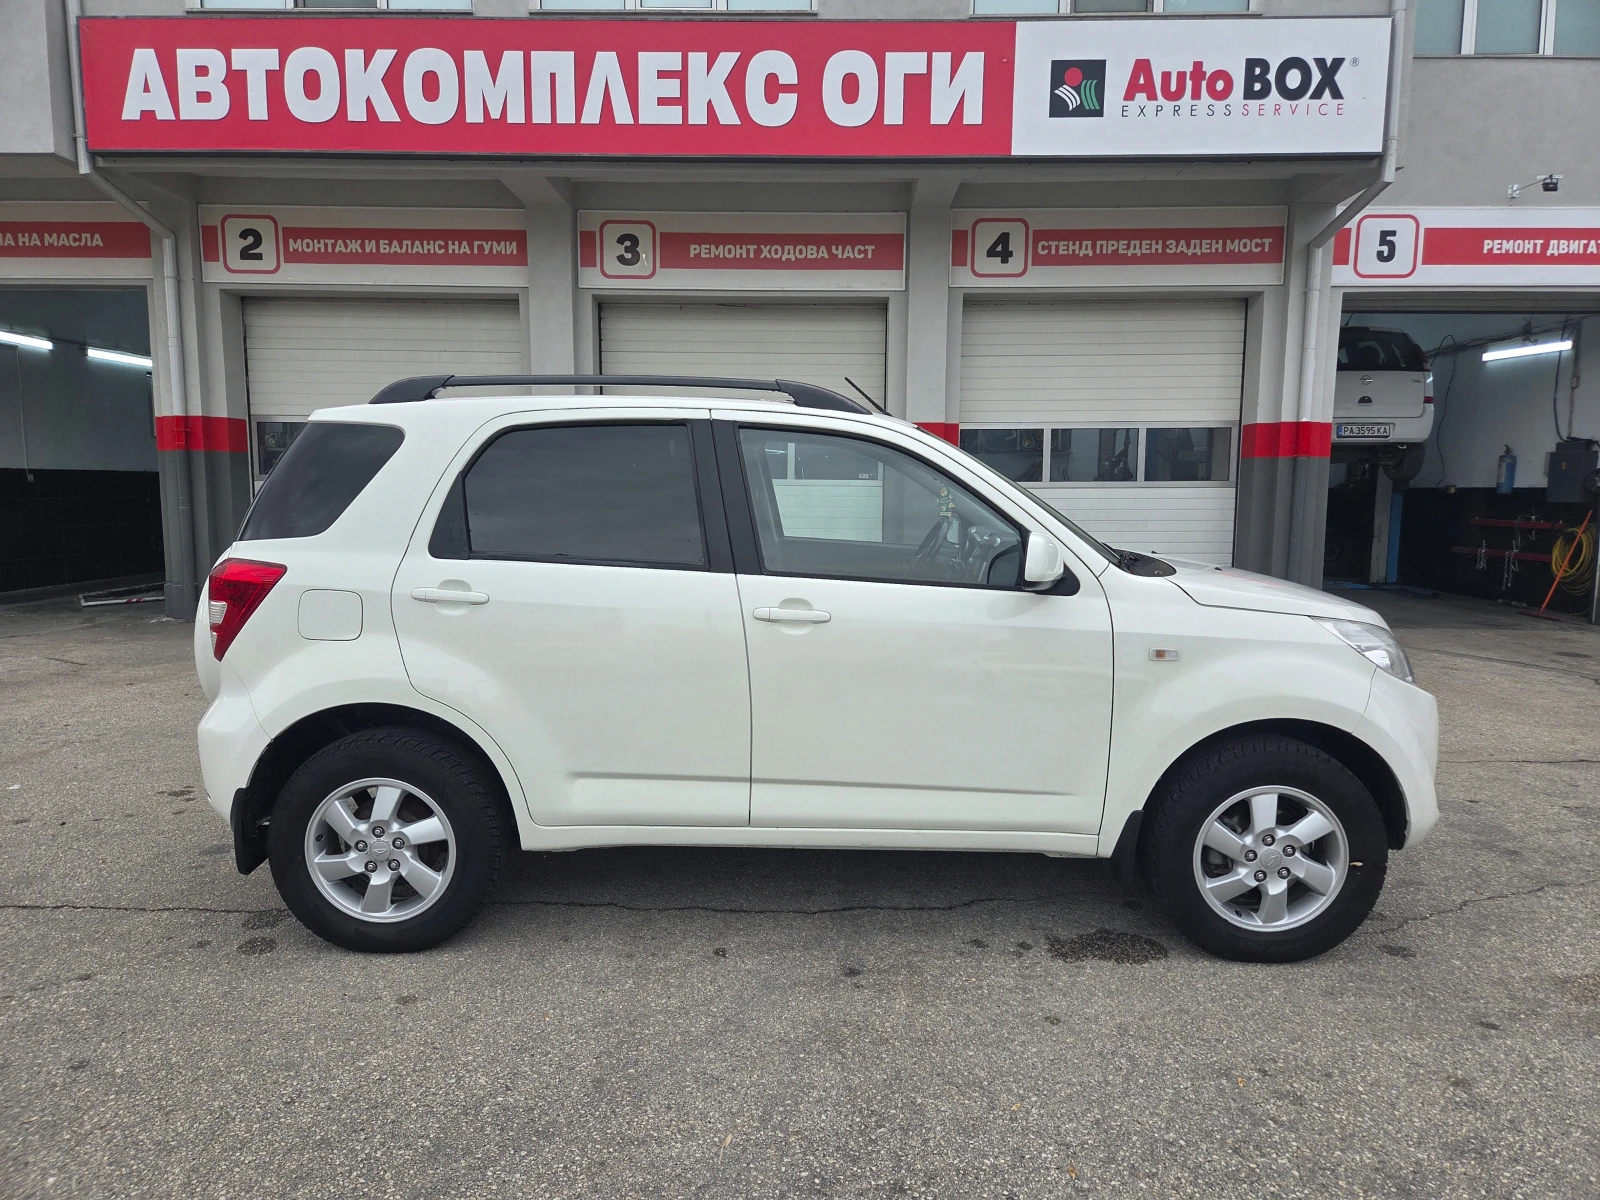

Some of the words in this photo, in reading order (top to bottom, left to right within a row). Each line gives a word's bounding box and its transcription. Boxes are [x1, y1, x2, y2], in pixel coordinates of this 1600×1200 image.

[121, 46, 799, 127] АВТОКОМПЛЕКС
[821, 49, 985, 127] ОГИ
[1123, 58, 1234, 102] Auto
[0, 233, 15, 247] А
[17, 232, 42, 247] НА
[43, 232, 104, 247] МАСЛА
[238, 228, 264, 261] 2
[288, 238, 364, 253] МОНТАЖ
[364, 239, 377, 253] И
[379, 239, 446, 254] БАЛАНС
[447, 240, 472, 255] НА
[473, 240, 517, 255] ГУМИ
[615, 233, 641, 267] 3
[689, 244, 758, 259] РЕМОНТ
[759, 244, 829, 262] ХОДОВА
[831, 244, 876, 259] ЧАСТ
[985, 231, 1014, 265] 4
[1037, 240, 1093, 258] СТЕНД
[1095, 240, 1163, 257] ПРЕДЕН
[1165, 239, 1223, 256] ЗАДЕН
[1225, 238, 1273, 253] МОСТ
[1376, 229, 1397, 263] 5
[1483, 239, 1544, 254] РЕМОНТ
[1546, 239, 1600, 257] ДВИГА
